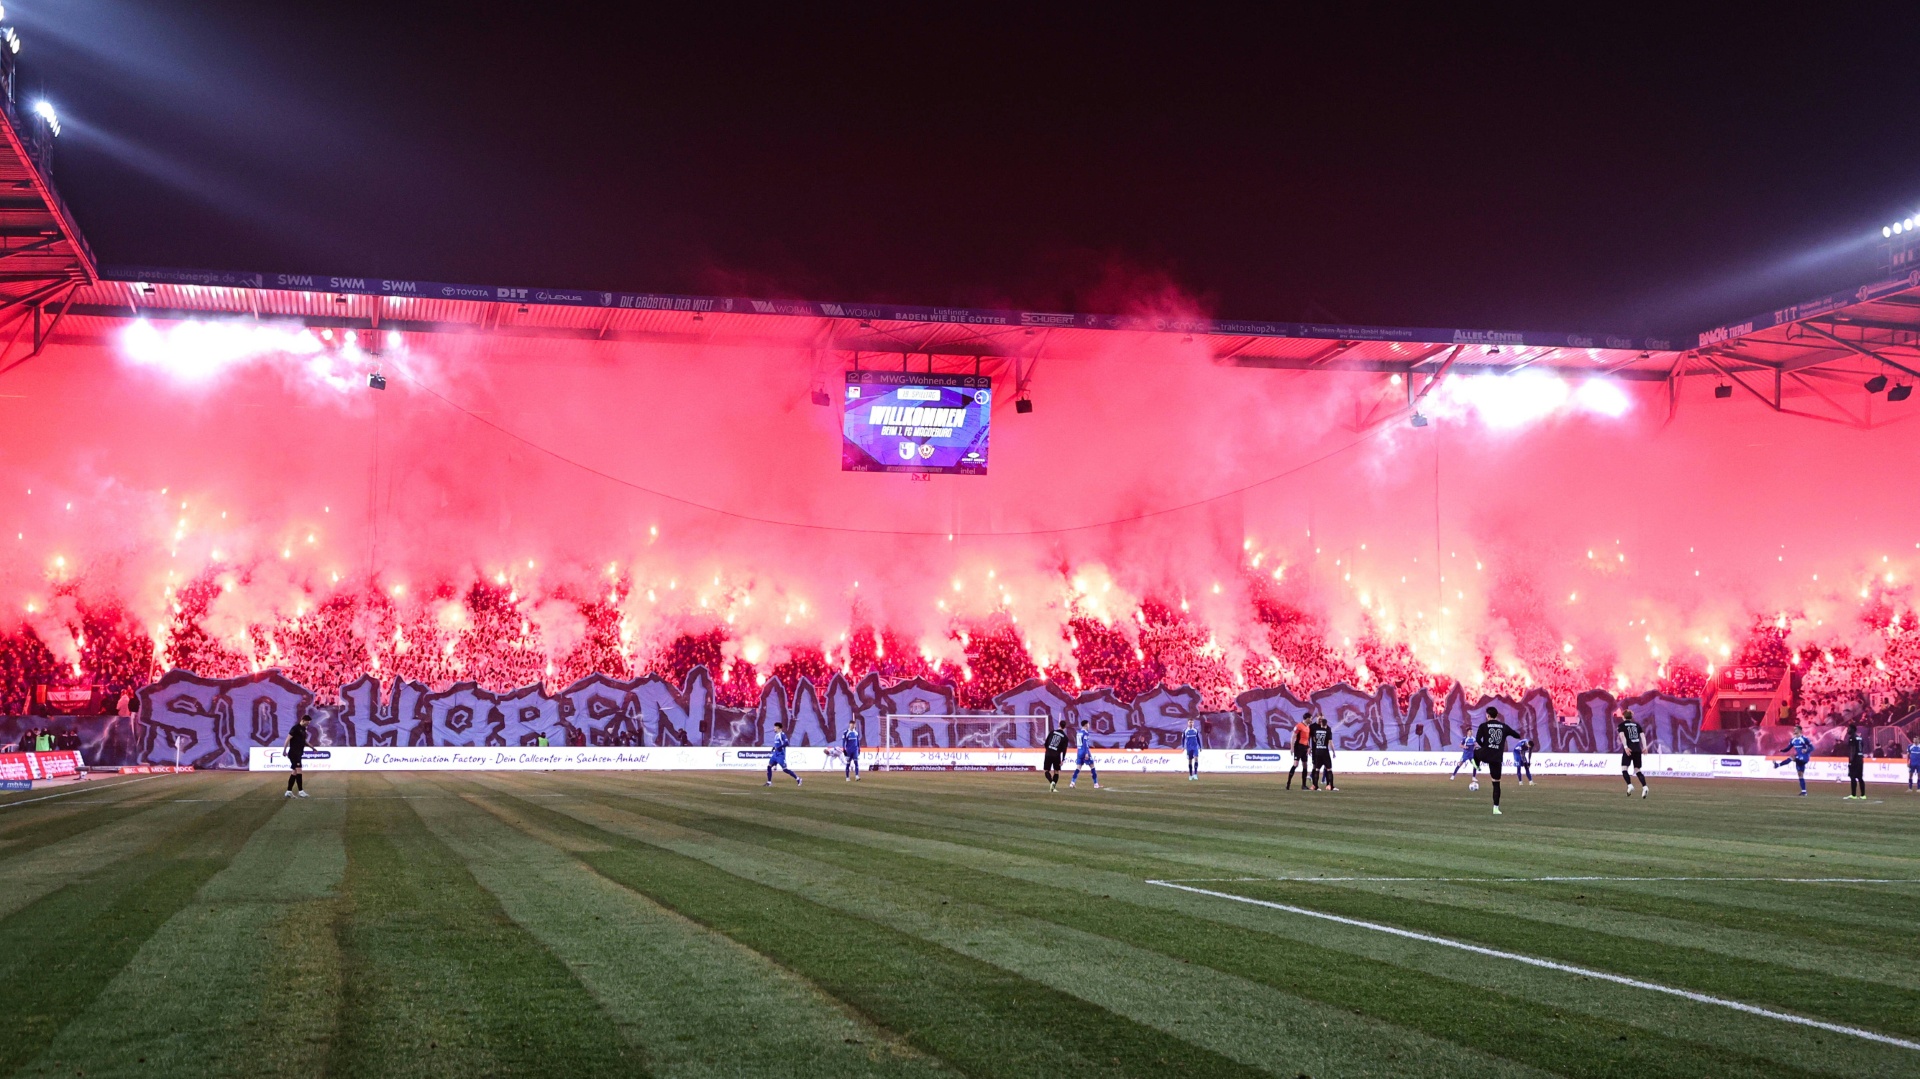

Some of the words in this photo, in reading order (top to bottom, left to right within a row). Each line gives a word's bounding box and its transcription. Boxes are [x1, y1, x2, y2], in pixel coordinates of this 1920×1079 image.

[278, 274, 314, 287] SWM
[330, 277, 365, 289] SWM
[382, 280, 417, 293] SWM
[457, 289, 489, 297] TOYOTA
[620, 295, 634, 308] DIE
[674, 298, 692, 310] DER
[692, 299, 714, 312] WELT
[776, 305, 812, 315] WOBAU
[844, 308, 880, 318] WOBAU
[895, 312, 928, 321] BADEN
[930, 314, 948, 322] WIE
[950, 315, 966, 323] DIE
[968, 315, 1007, 324] GÖTTER
[1021, 312, 1075, 324] SCHUBERT
[1311, 326, 1360, 335] Trocken-Aus-Bau
[1453, 330, 1524, 341] ALLEE-CENTER
[1574, 337, 1594, 347] GIS
[1614, 339, 1632, 349] GIS
[1652, 340, 1670, 350] GIS
[880, 376, 957, 386] MWG-Wohnen.de
[869, 405, 967, 428] WILLKOMMEN
[881, 425, 898, 436] BEIM
[904, 427, 914, 437] FC
[913, 427, 953, 438] MAGDEBURG
[960, 467, 976, 475] intel
[364, 752, 381, 765] Die
[382, 753, 450, 764] Communication
[452, 753, 487, 765] Factory
[495, 752, 517, 765] Dein
[519, 753, 563, 764] Callcenter
[564, 754, 574, 764] in
[576, 752, 651, 764] Sachsen-Anhalt!
[928, 752, 963, 761] 84,940
[1104, 756, 1115, 765] als
[1117, 757, 1129, 765] ein
[1131, 755, 1170, 765] Callcenter
[1366, 757, 1380, 767] Die
[1382, 758, 1438, 767] Communication
[1534, 759, 1542, 767] in
[1544, 758, 1608, 769] Sachsen-Anhalt!
